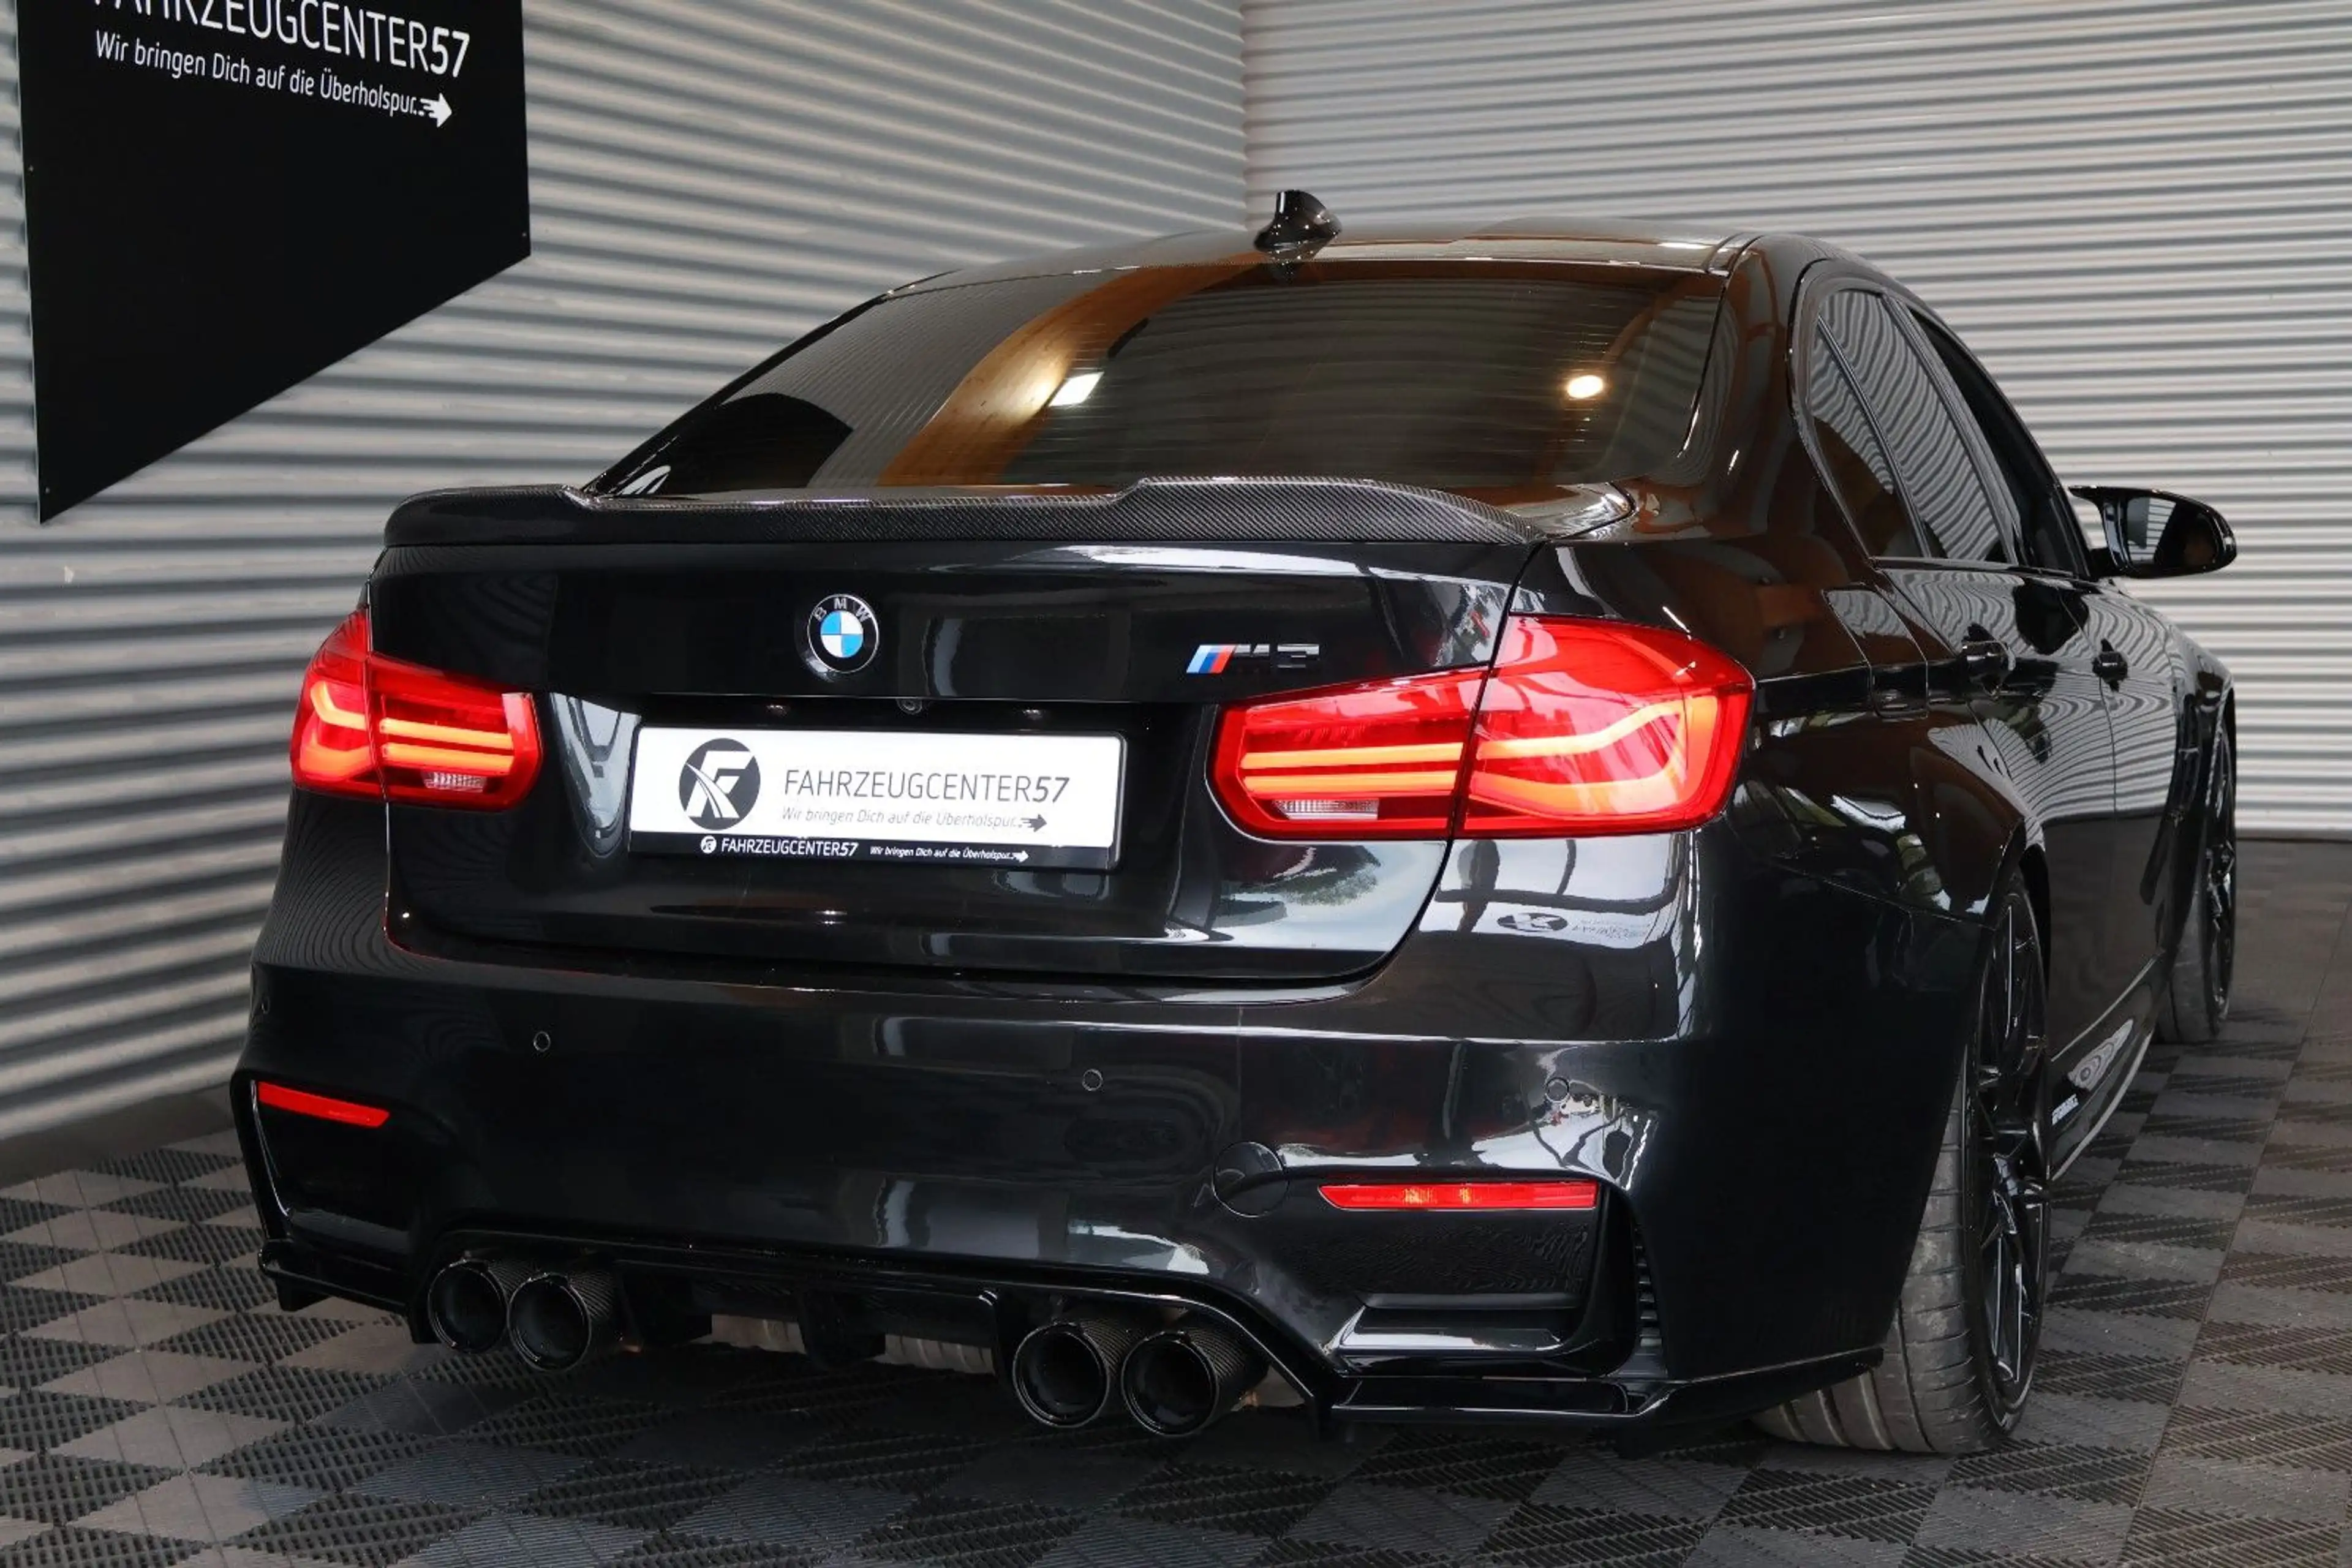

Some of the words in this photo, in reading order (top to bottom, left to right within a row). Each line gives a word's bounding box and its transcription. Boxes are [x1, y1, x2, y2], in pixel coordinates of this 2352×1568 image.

[95, 0, 470, 78] ZEUGCENTER57
[96, 29, 129, 61] Wir
[134, 37, 205, 79] bringen
[213, 53, 250, 85] Dich
[255, 65, 286, 91] auf
[290, 68, 315, 96] die
[812, 597, 872, 623] BMW
[784, 769, 1070, 803] FAHRZEUGCENTER57
[782, 806, 802, 821] Wir
[805, 808, 854, 824] bringen
[857, 809, 884, 824] Dich
[888, 810, 910, 824] auf
[913, 811, 933, 825] die
[720, 837, 859, 856] FAHRZEUGCENTER57
[870, 845, 884, 856] Wir
[885, 846, 914, 859] bringen
[915, 846, 933, 857] Dich
[933, 847, 948, 858] auf
[948, 847, 962, 858] die
